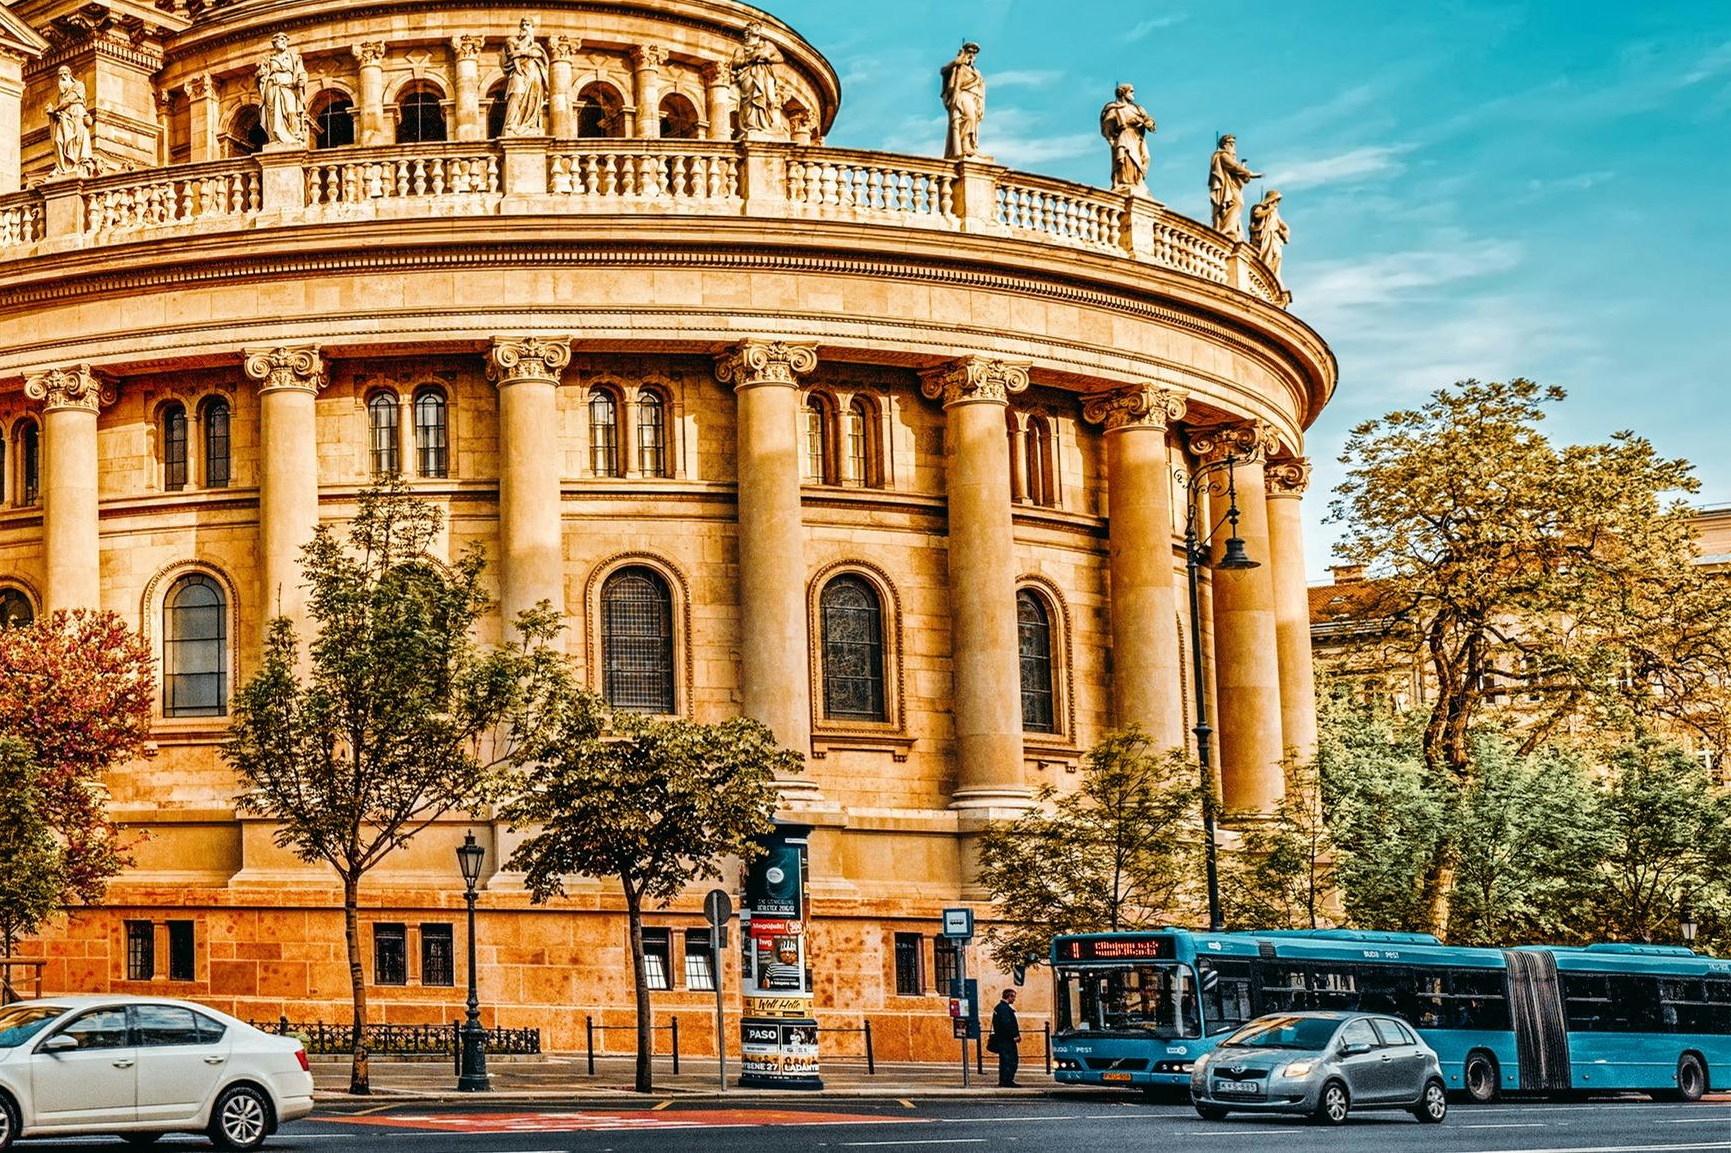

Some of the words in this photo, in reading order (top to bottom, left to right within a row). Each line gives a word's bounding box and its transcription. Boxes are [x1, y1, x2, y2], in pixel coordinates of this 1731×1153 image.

[758, 938, 772, 946] hvg
[758, 999, 778, 1010] Well
[779, 1000, 800, 1009] Hello
[749, 1030, 777, 1039] PASO
[766, 1063, 778, 1071] 27
